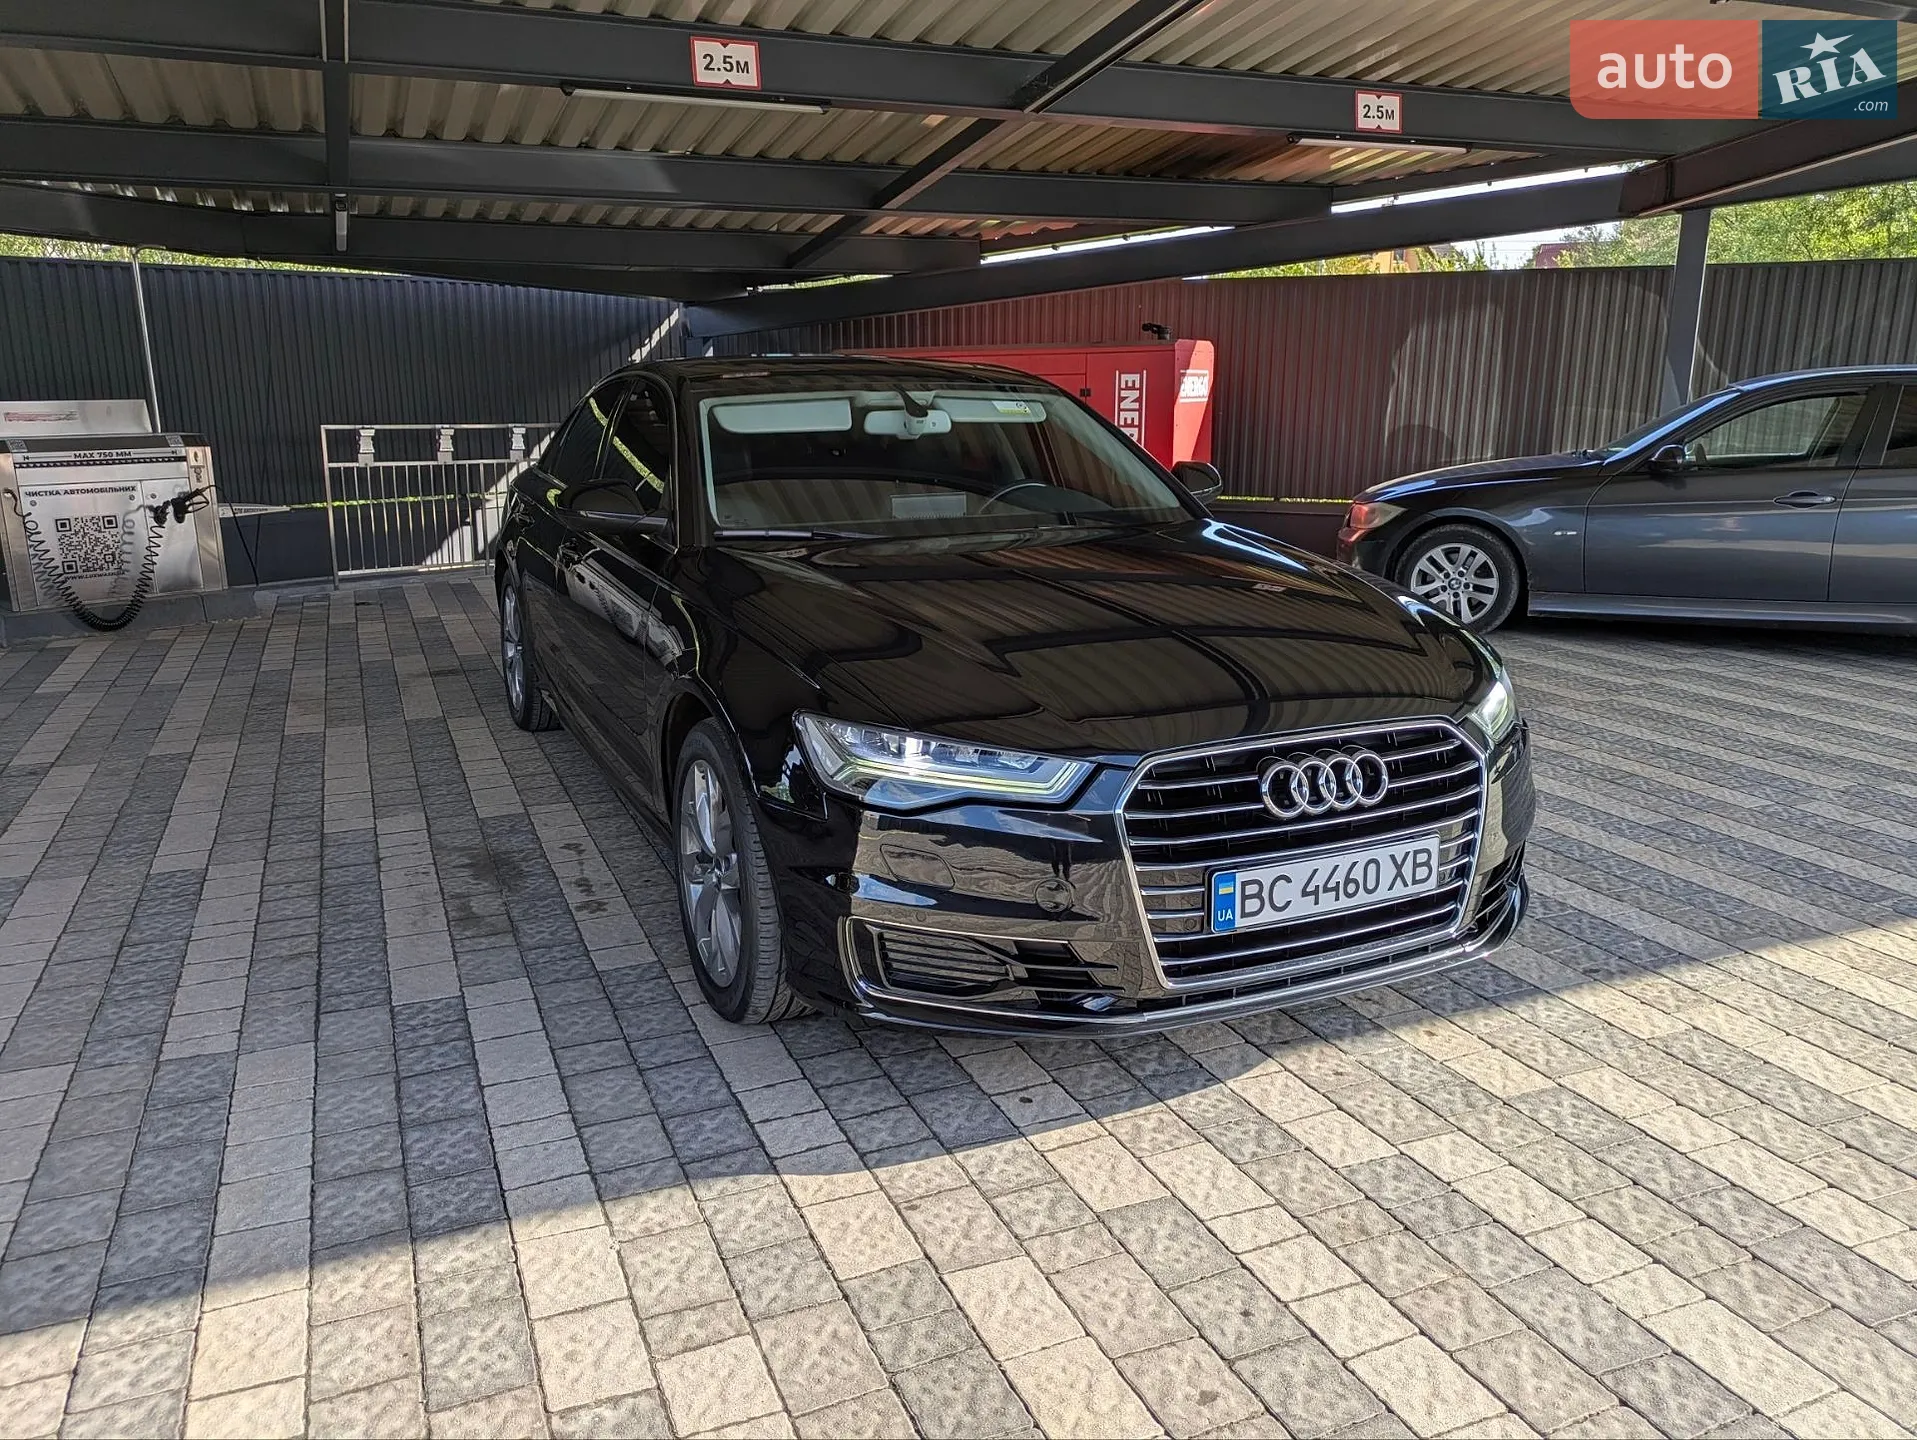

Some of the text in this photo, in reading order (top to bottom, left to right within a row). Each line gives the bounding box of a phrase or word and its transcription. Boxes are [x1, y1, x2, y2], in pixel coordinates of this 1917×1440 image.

[73, 451, 95, 459] MAX
[24, 485, 137, 498] ЧИСТКА АВТОМОБІЛЬНИХ
[1240, 847, 1433, 919] BC 4460 XB
[1217, 909, 1234, 922] UA
